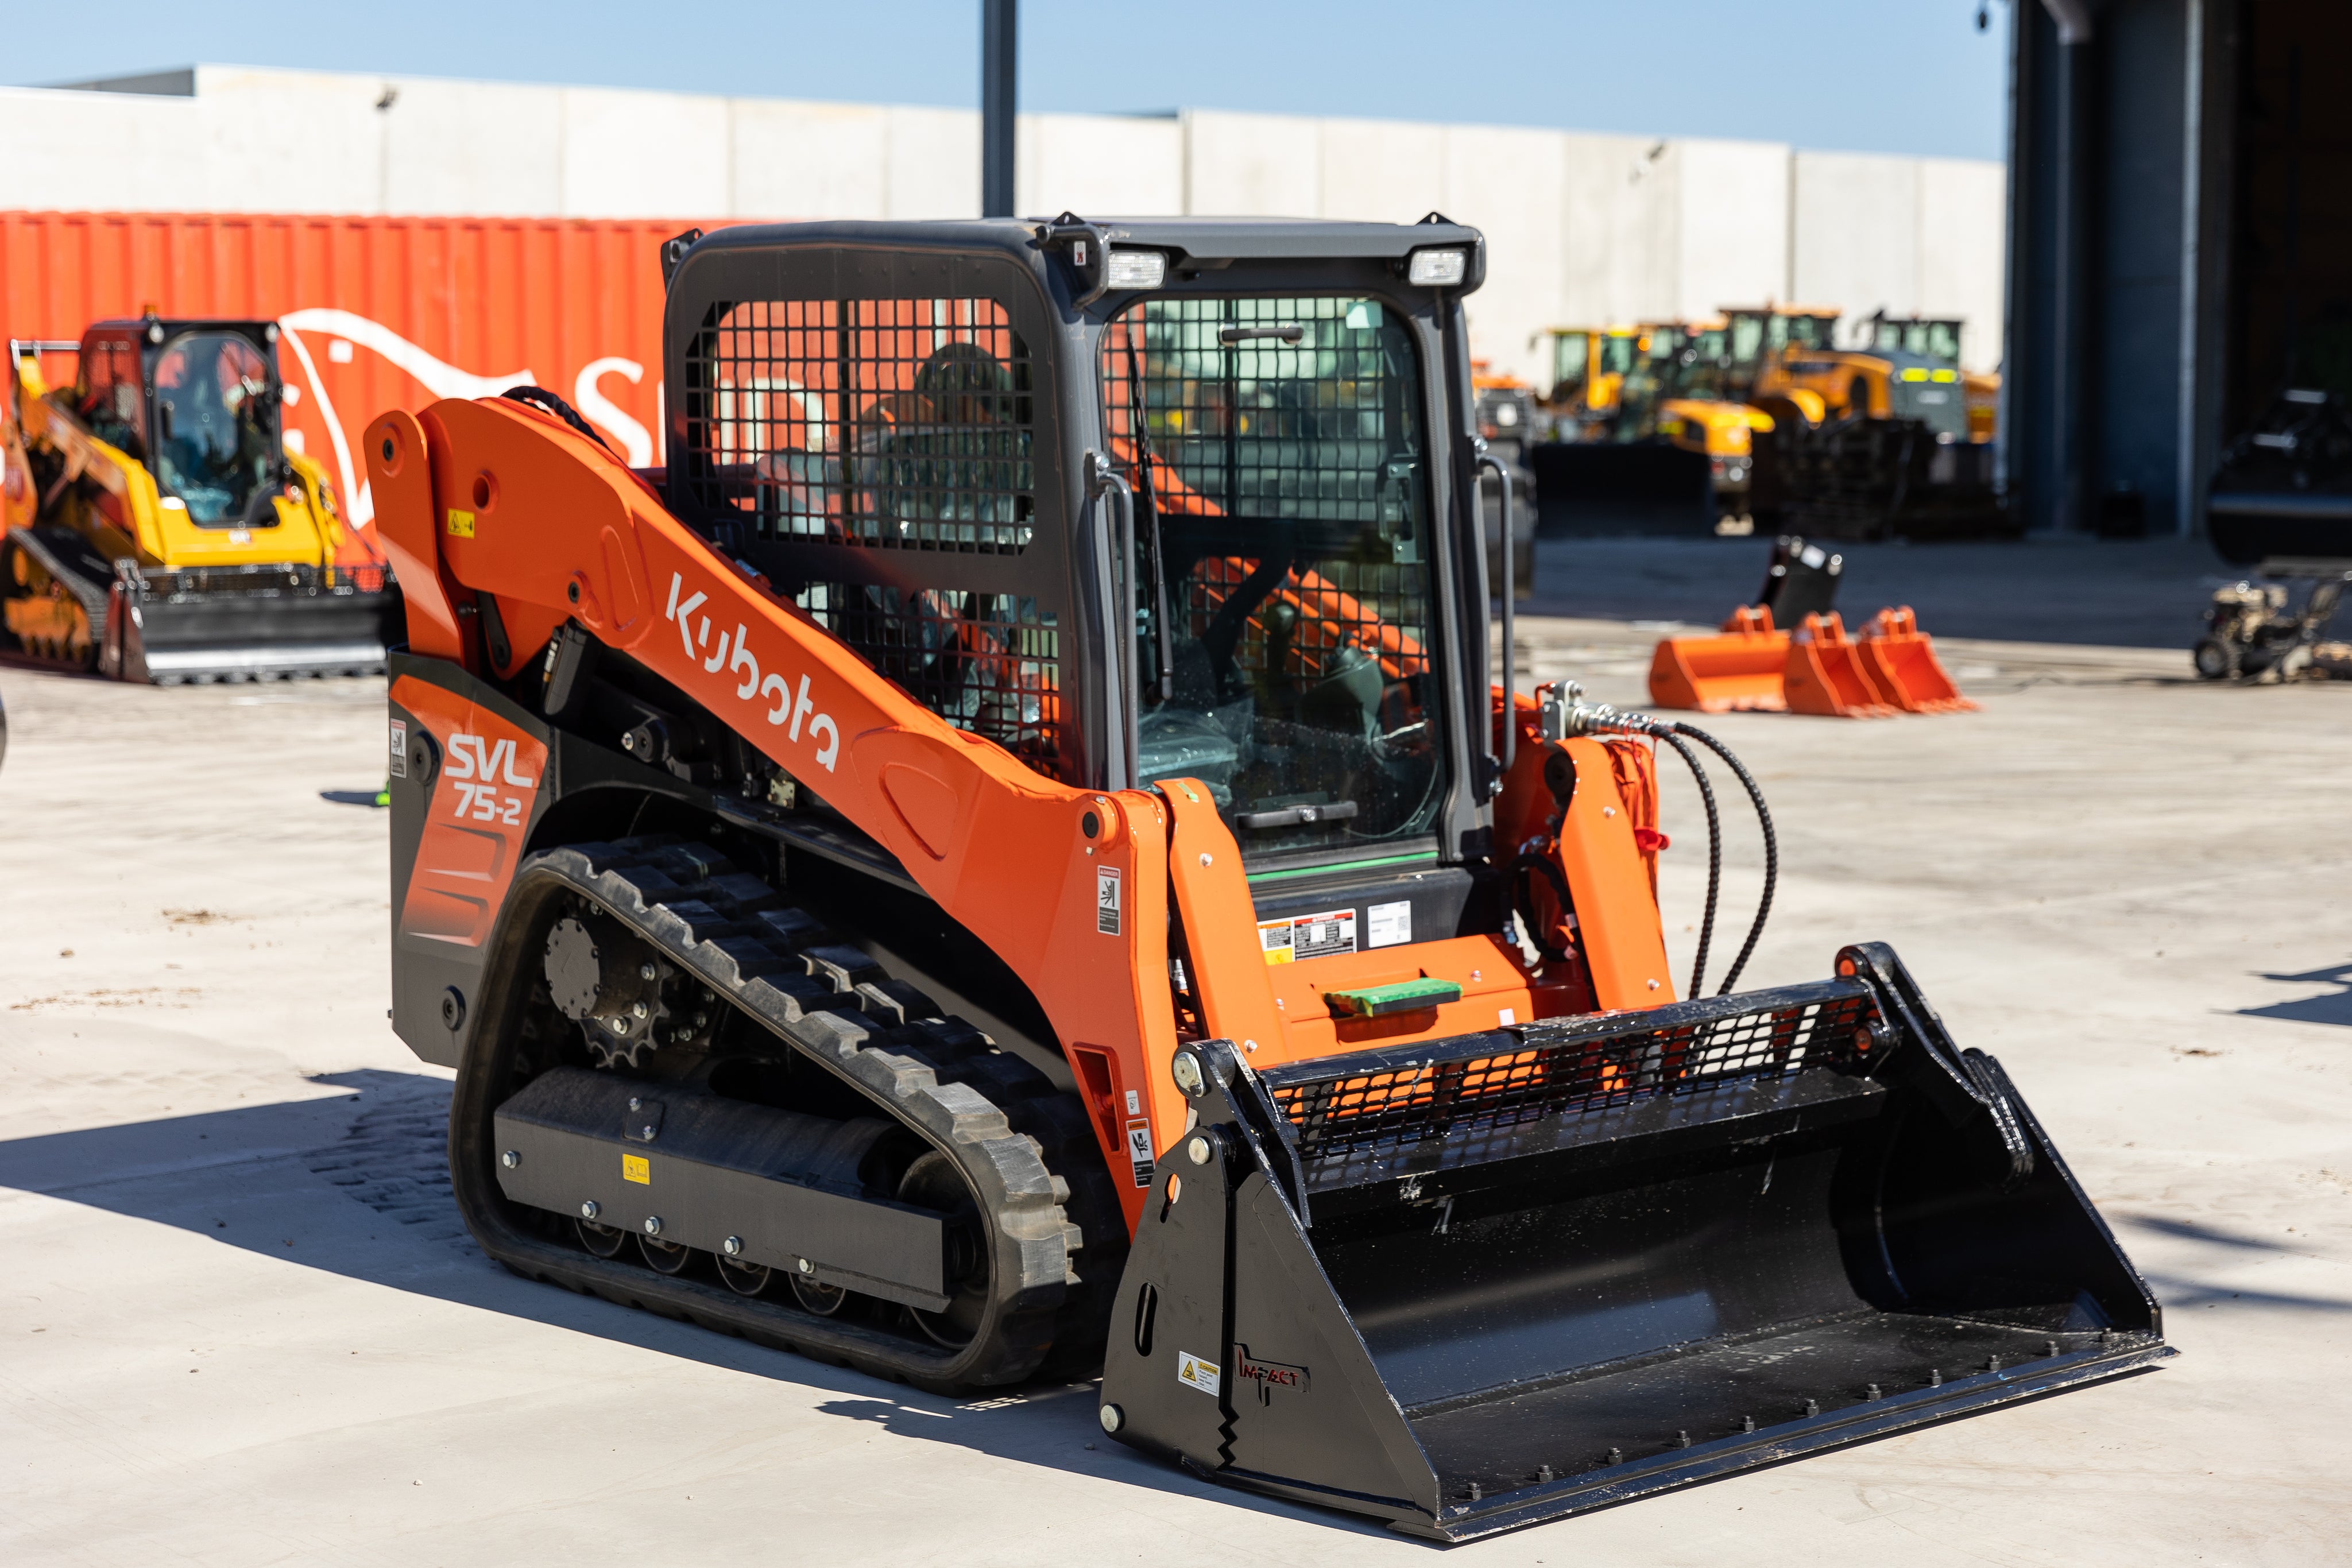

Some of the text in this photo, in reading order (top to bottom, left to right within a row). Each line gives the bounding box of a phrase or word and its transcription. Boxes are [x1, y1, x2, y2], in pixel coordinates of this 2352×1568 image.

[665, 571, 840, 773] Kubota
[444, 732, 533, 788] SVL
[453, 781, 522, 826] 75-2
[1203, 1365, 1217, 1373] CAUTION
